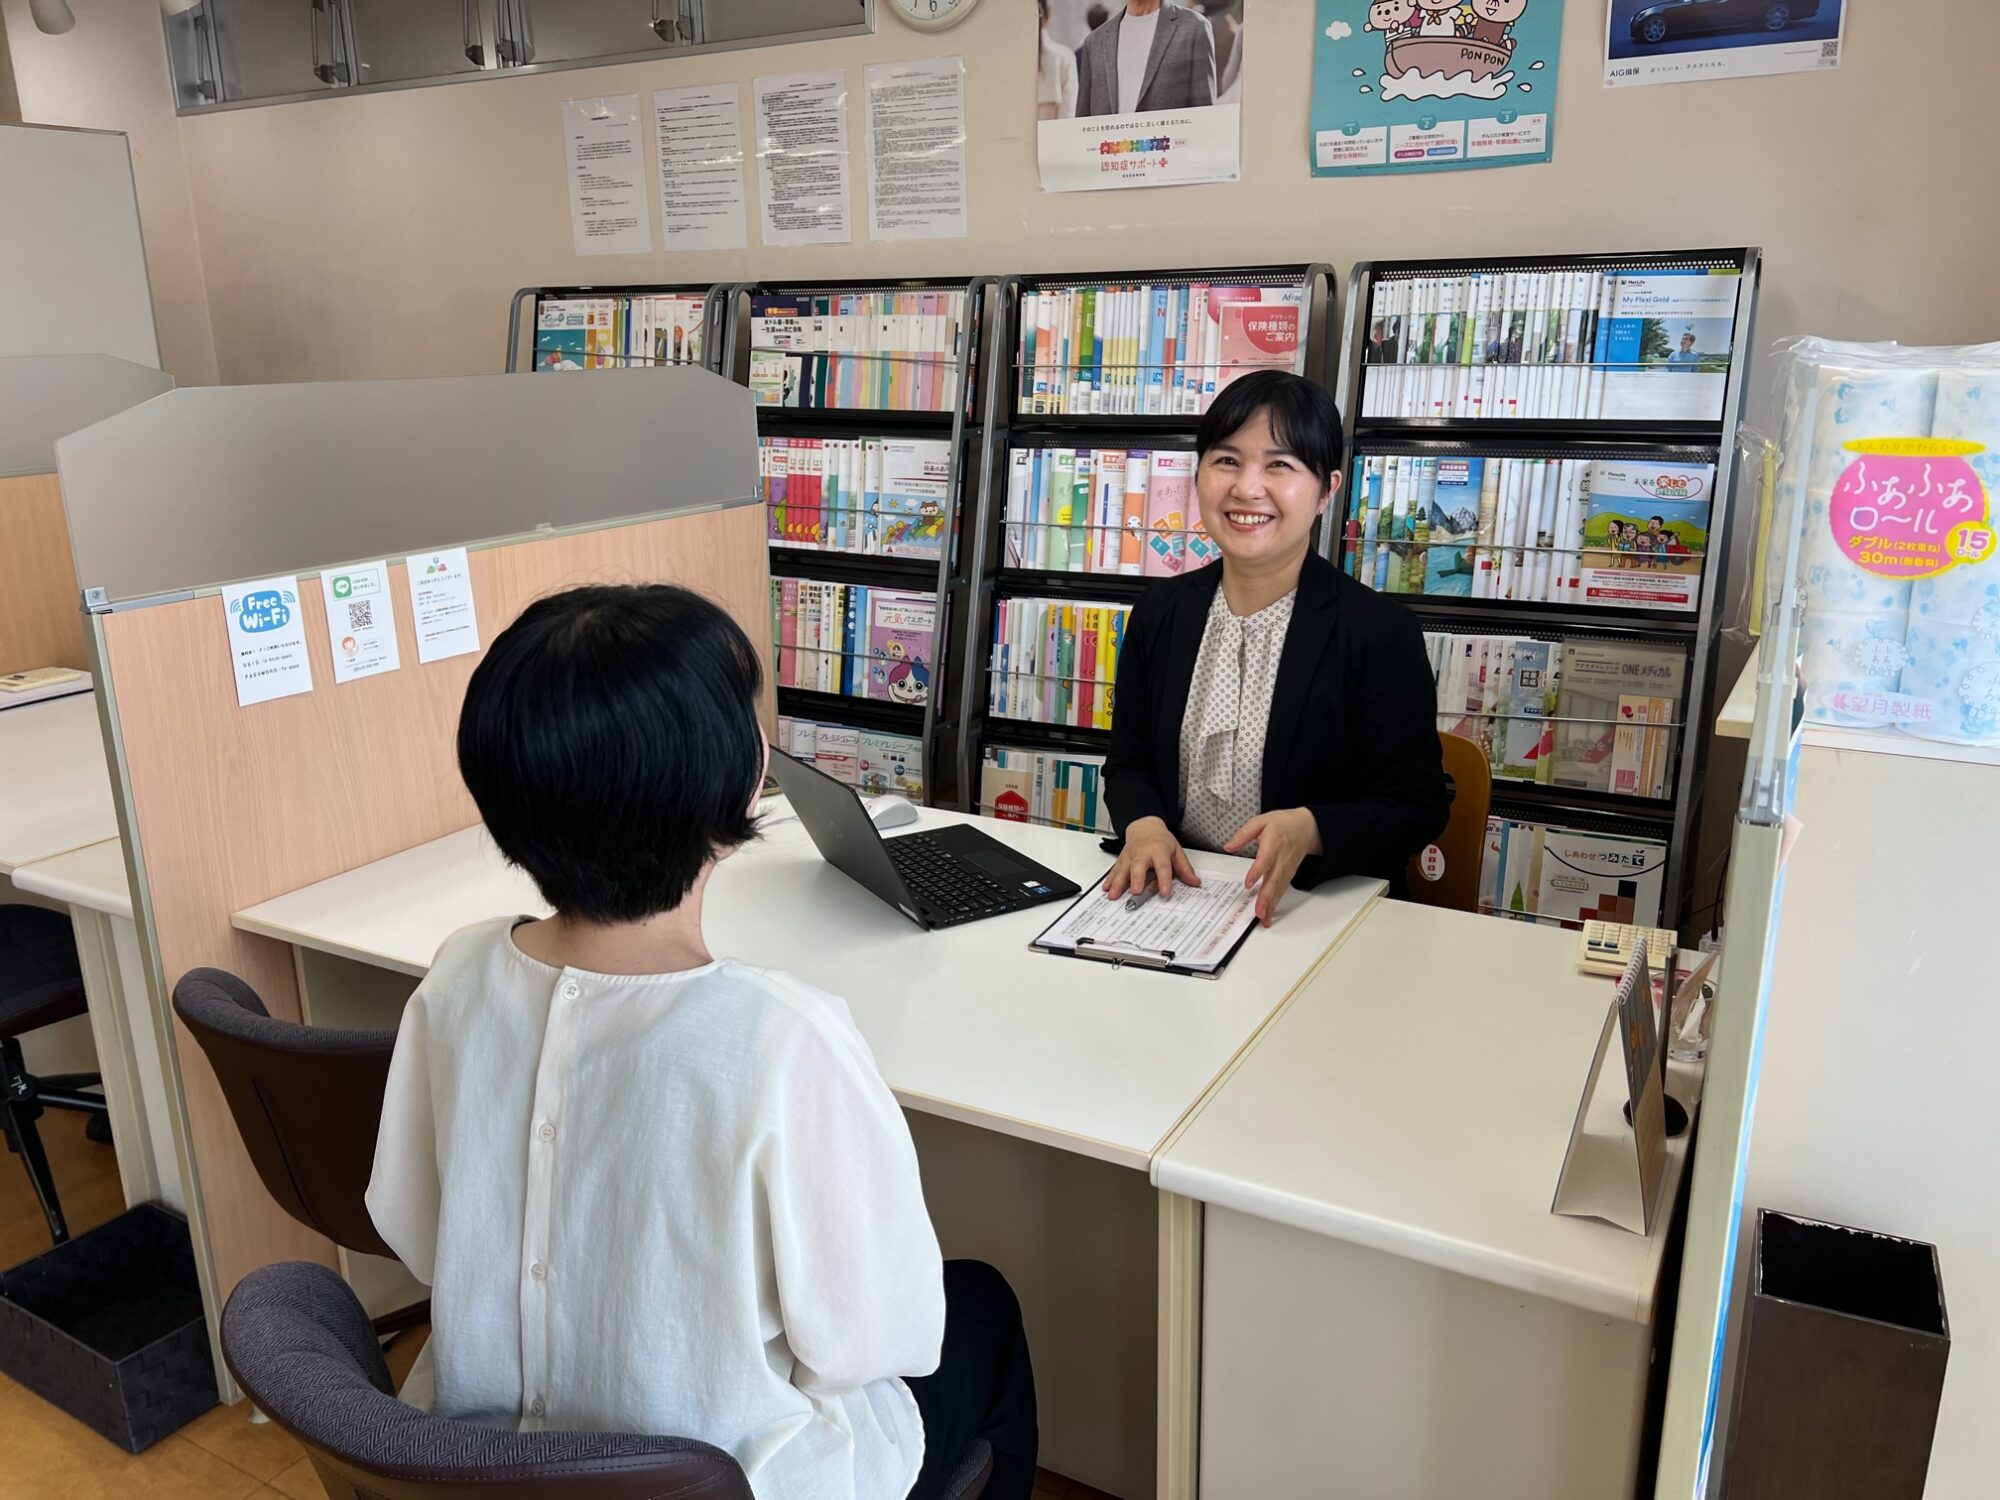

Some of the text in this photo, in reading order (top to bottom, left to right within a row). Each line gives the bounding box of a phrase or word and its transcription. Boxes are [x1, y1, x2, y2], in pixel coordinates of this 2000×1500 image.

[1461, 48, 1505, 66] PON PON
[1609, 67, 1640, 77] AIG損保
[1503, 114, 1509, 122] 3
[1424, 120, 1430, 129] 2
[1623, 296, 1633, 305] My
[1653, 295, 1670, 303] Gold
[1248, 320, 1296, 332] 保険種類の
[1265, 332, 1295, 343] ご案内
[1957, 528, 1989, 549] 15
[1956, 547, 1980, 558] ロール
[247, 595, 278, 611] Free
[242, 608, 288, 630] Wi-Fi
[1621, 663, 1672, 679] ONEメディカル
[1851, 694, 1933, 720] 望月製紙
